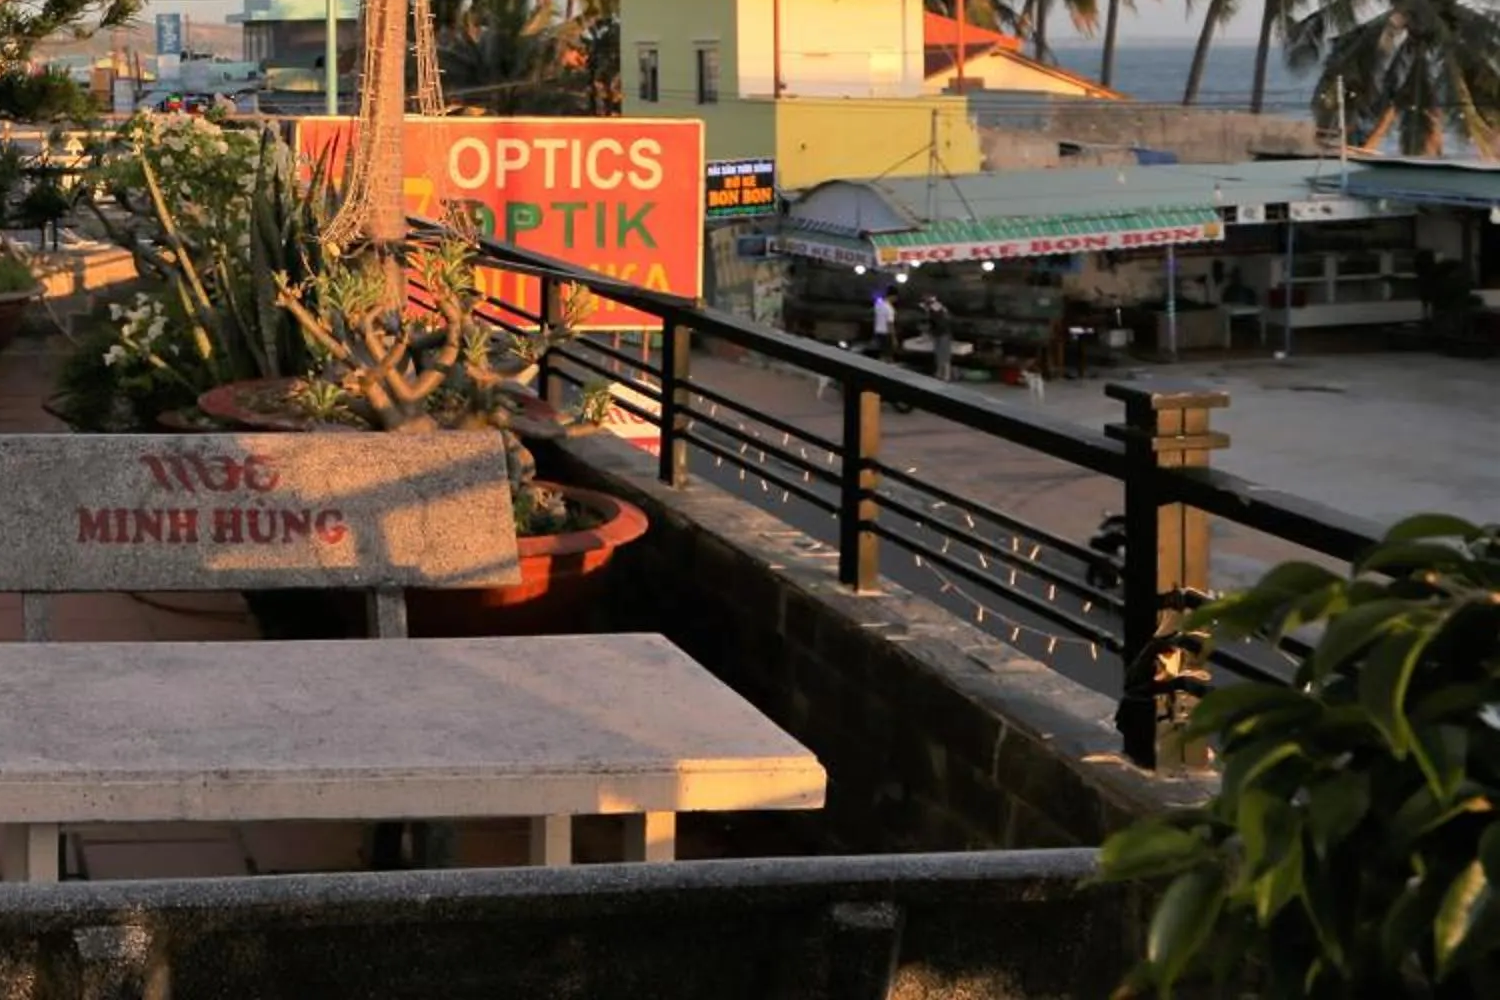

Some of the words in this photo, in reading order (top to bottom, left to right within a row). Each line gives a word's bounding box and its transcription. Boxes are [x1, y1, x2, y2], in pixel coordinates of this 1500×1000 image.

[448, 137, 664, 190] OPTICS
[708, 190, 739, 207] BON
[742, 187, 773, 204] BON
[1030, 235, 1108, 252] BON
[1122, 227, 1199, 245] BON
[77, 507, 199, 544] MINH
